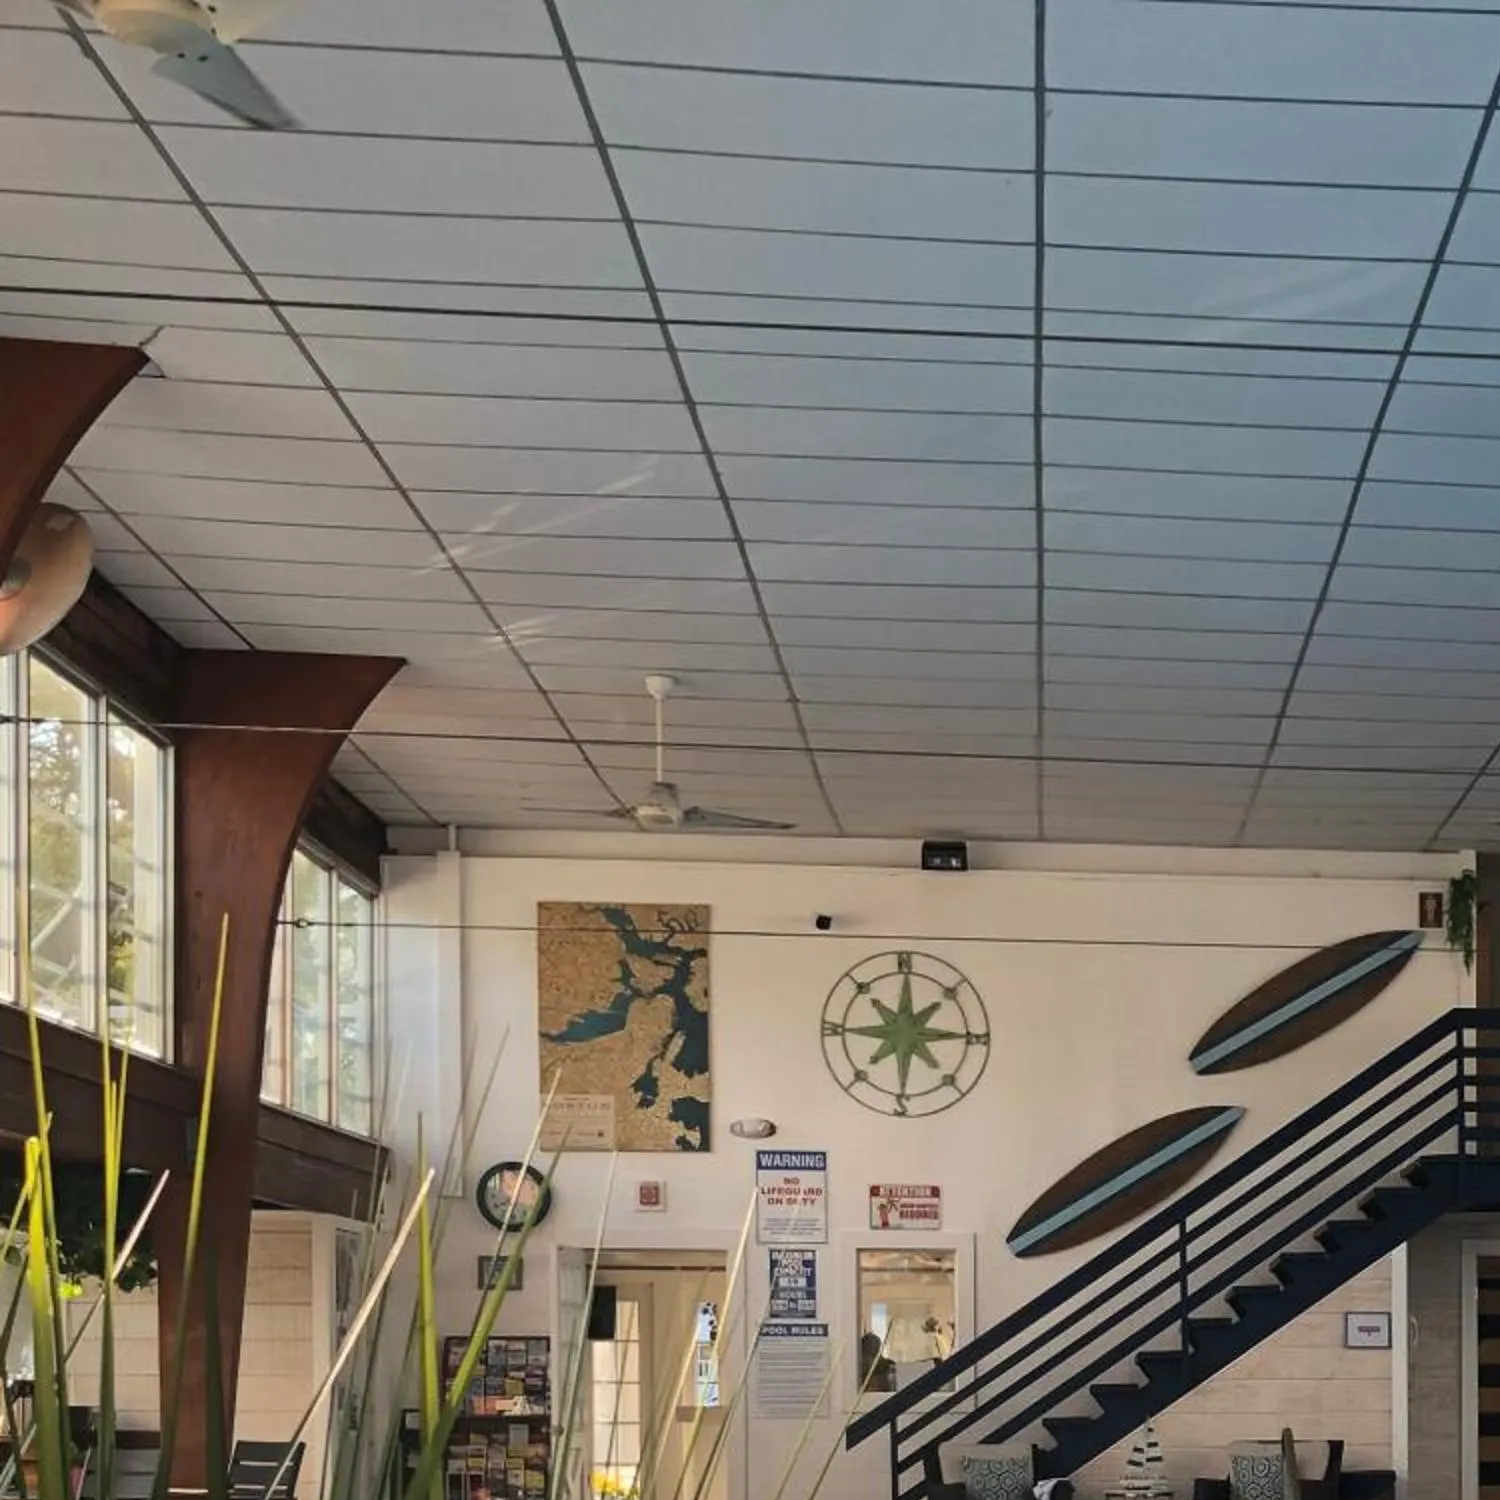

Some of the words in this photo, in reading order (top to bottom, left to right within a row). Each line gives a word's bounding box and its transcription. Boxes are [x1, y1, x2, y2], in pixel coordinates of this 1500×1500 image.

[760, 1153, 825, 1168] WARNING
[783, 1176, 800, 1185] NO
[767, 1197, 783, 1205] ON
[786, 1197, 817, 1207] DTY
[762, 1326, 788, 1335] POOL
